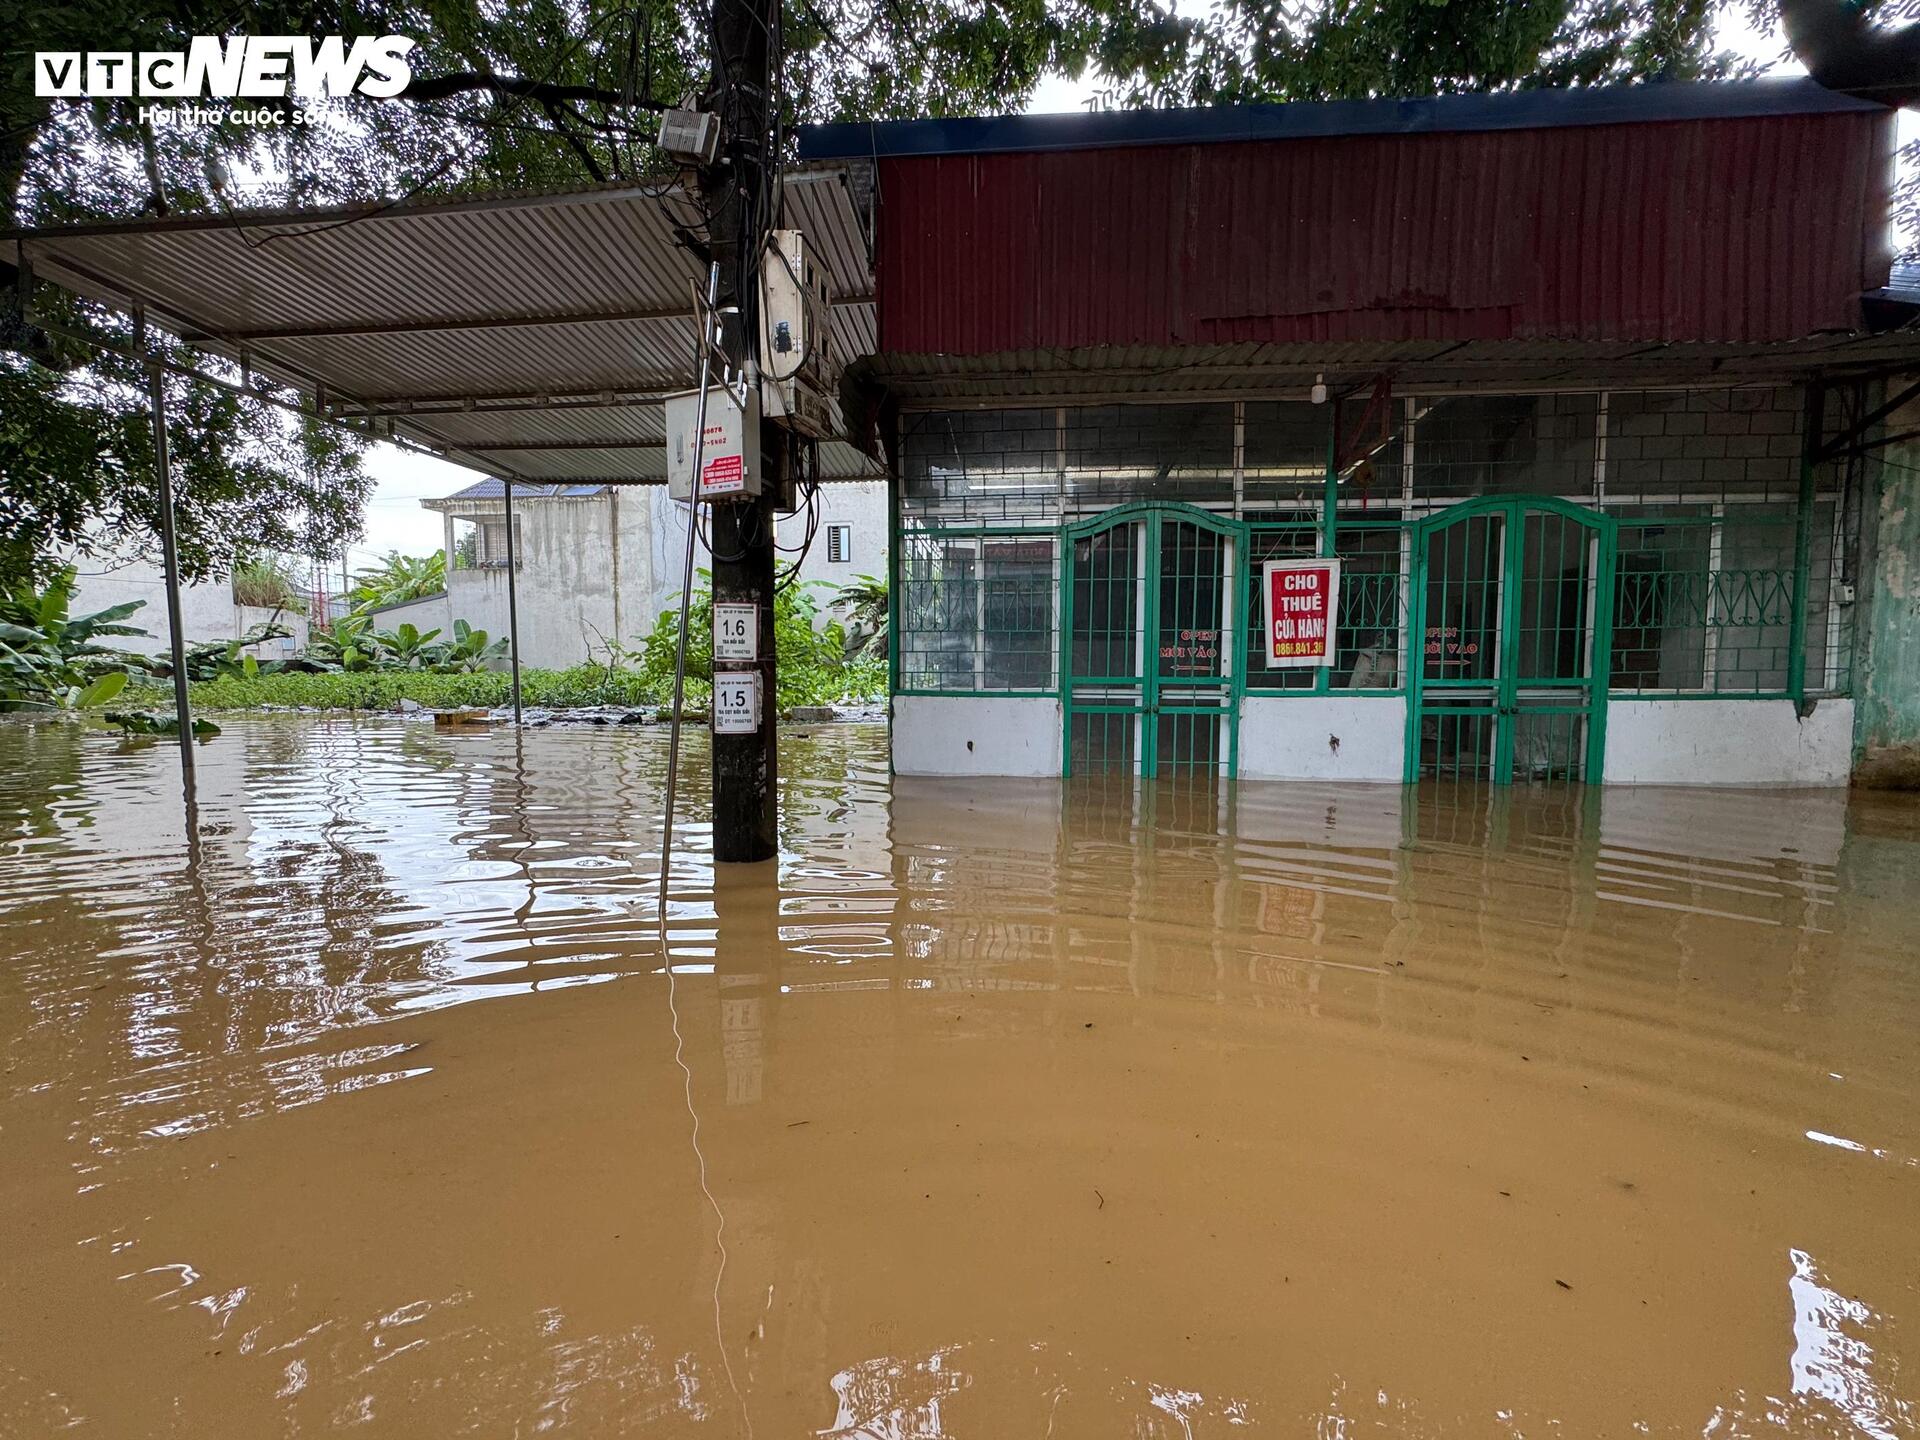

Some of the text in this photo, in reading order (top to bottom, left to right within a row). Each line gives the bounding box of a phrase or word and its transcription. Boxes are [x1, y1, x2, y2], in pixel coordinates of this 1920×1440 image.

[1284, 574, 1318, 591] CHO
[1281, 592, 1322, 612] THUÊ
[722, 619, 745, 636] 1.6
[1275, 613, 1296, 640] CỬA
[721, 690, 746, 707] 1.5
